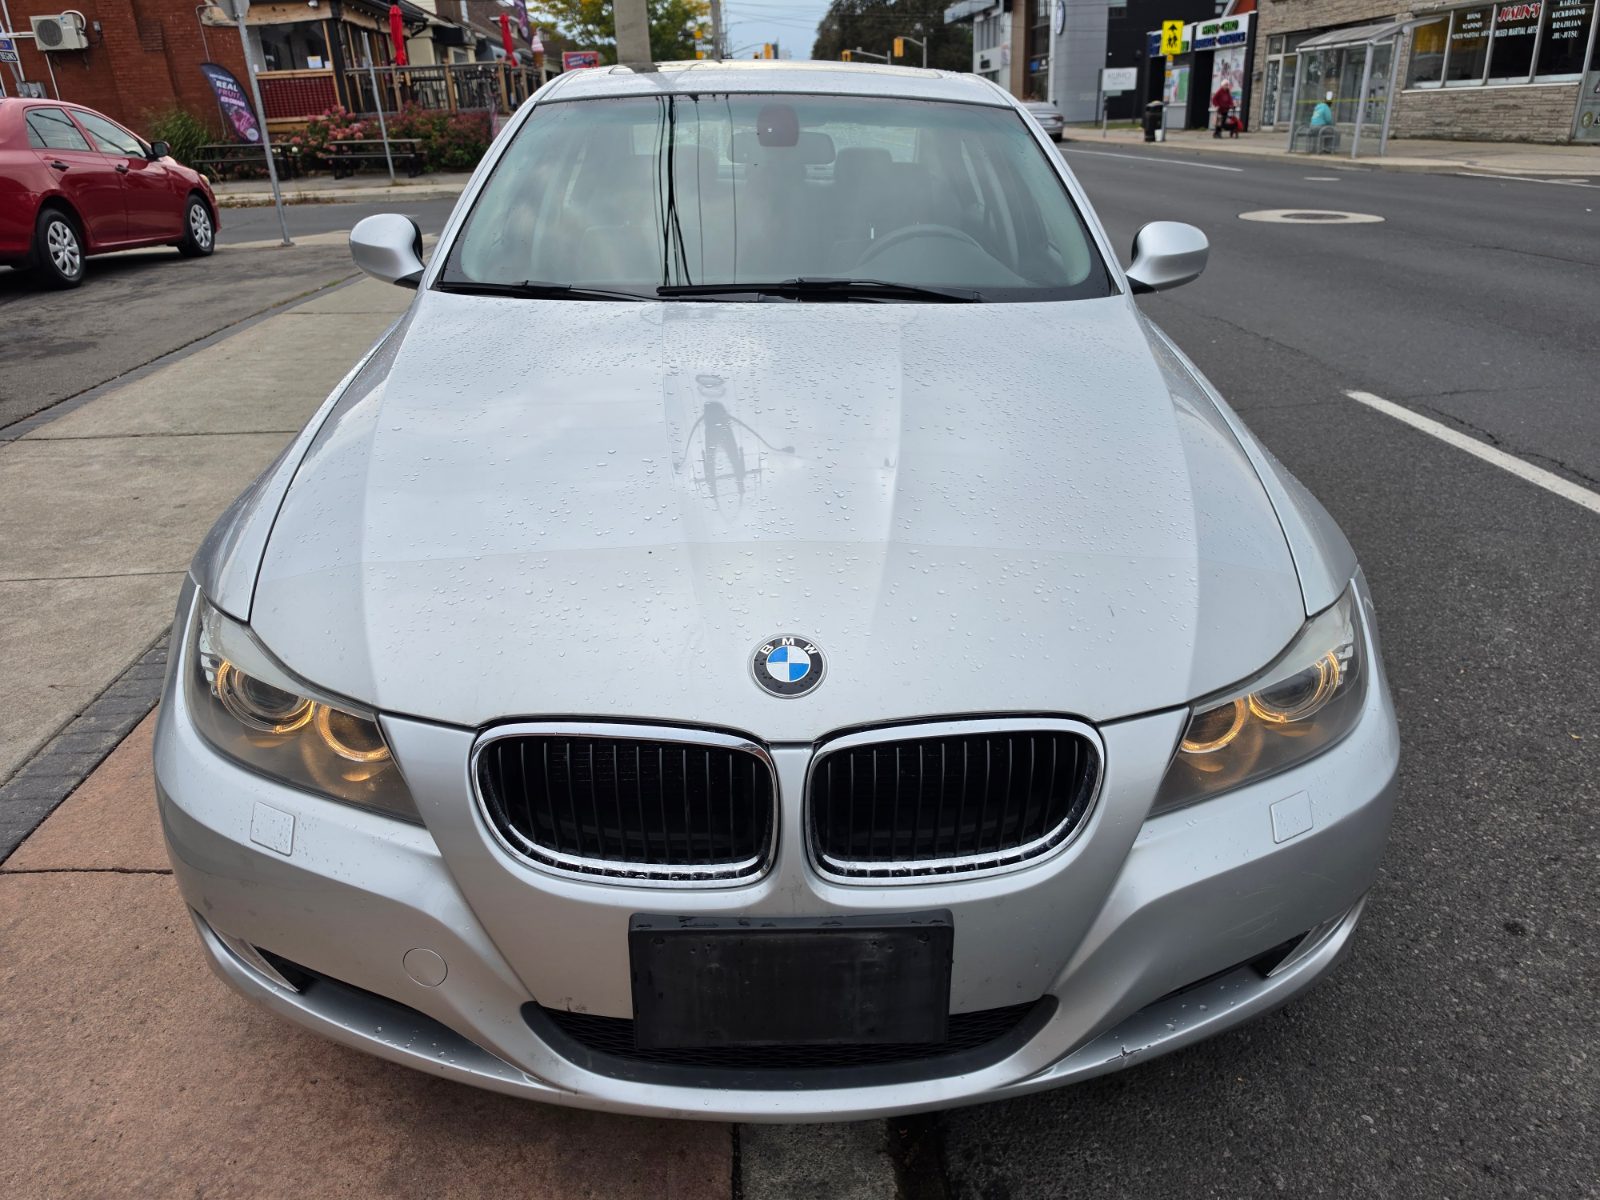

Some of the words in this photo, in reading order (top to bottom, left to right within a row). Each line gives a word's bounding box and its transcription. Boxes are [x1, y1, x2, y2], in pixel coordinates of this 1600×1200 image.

[1497, 3, 1541, 22] JOSLIN'S
[1552, 8, 1586, 18] KICKBOXING
[1552, 20, 1582, 29] BRAZILIAN
[1494, 29, 1508, 37] MIXED
[1508, 26, 1526, 36] MARTIAL
[1526, 25, 1539, 34] ARTS
[1552, 30, 1578, 39] JIU-JITSU
[216, 80, 239, 91] REAL
[218, 88, 241, 99] FRUIT
[759, 637, 818, 655] BMW
